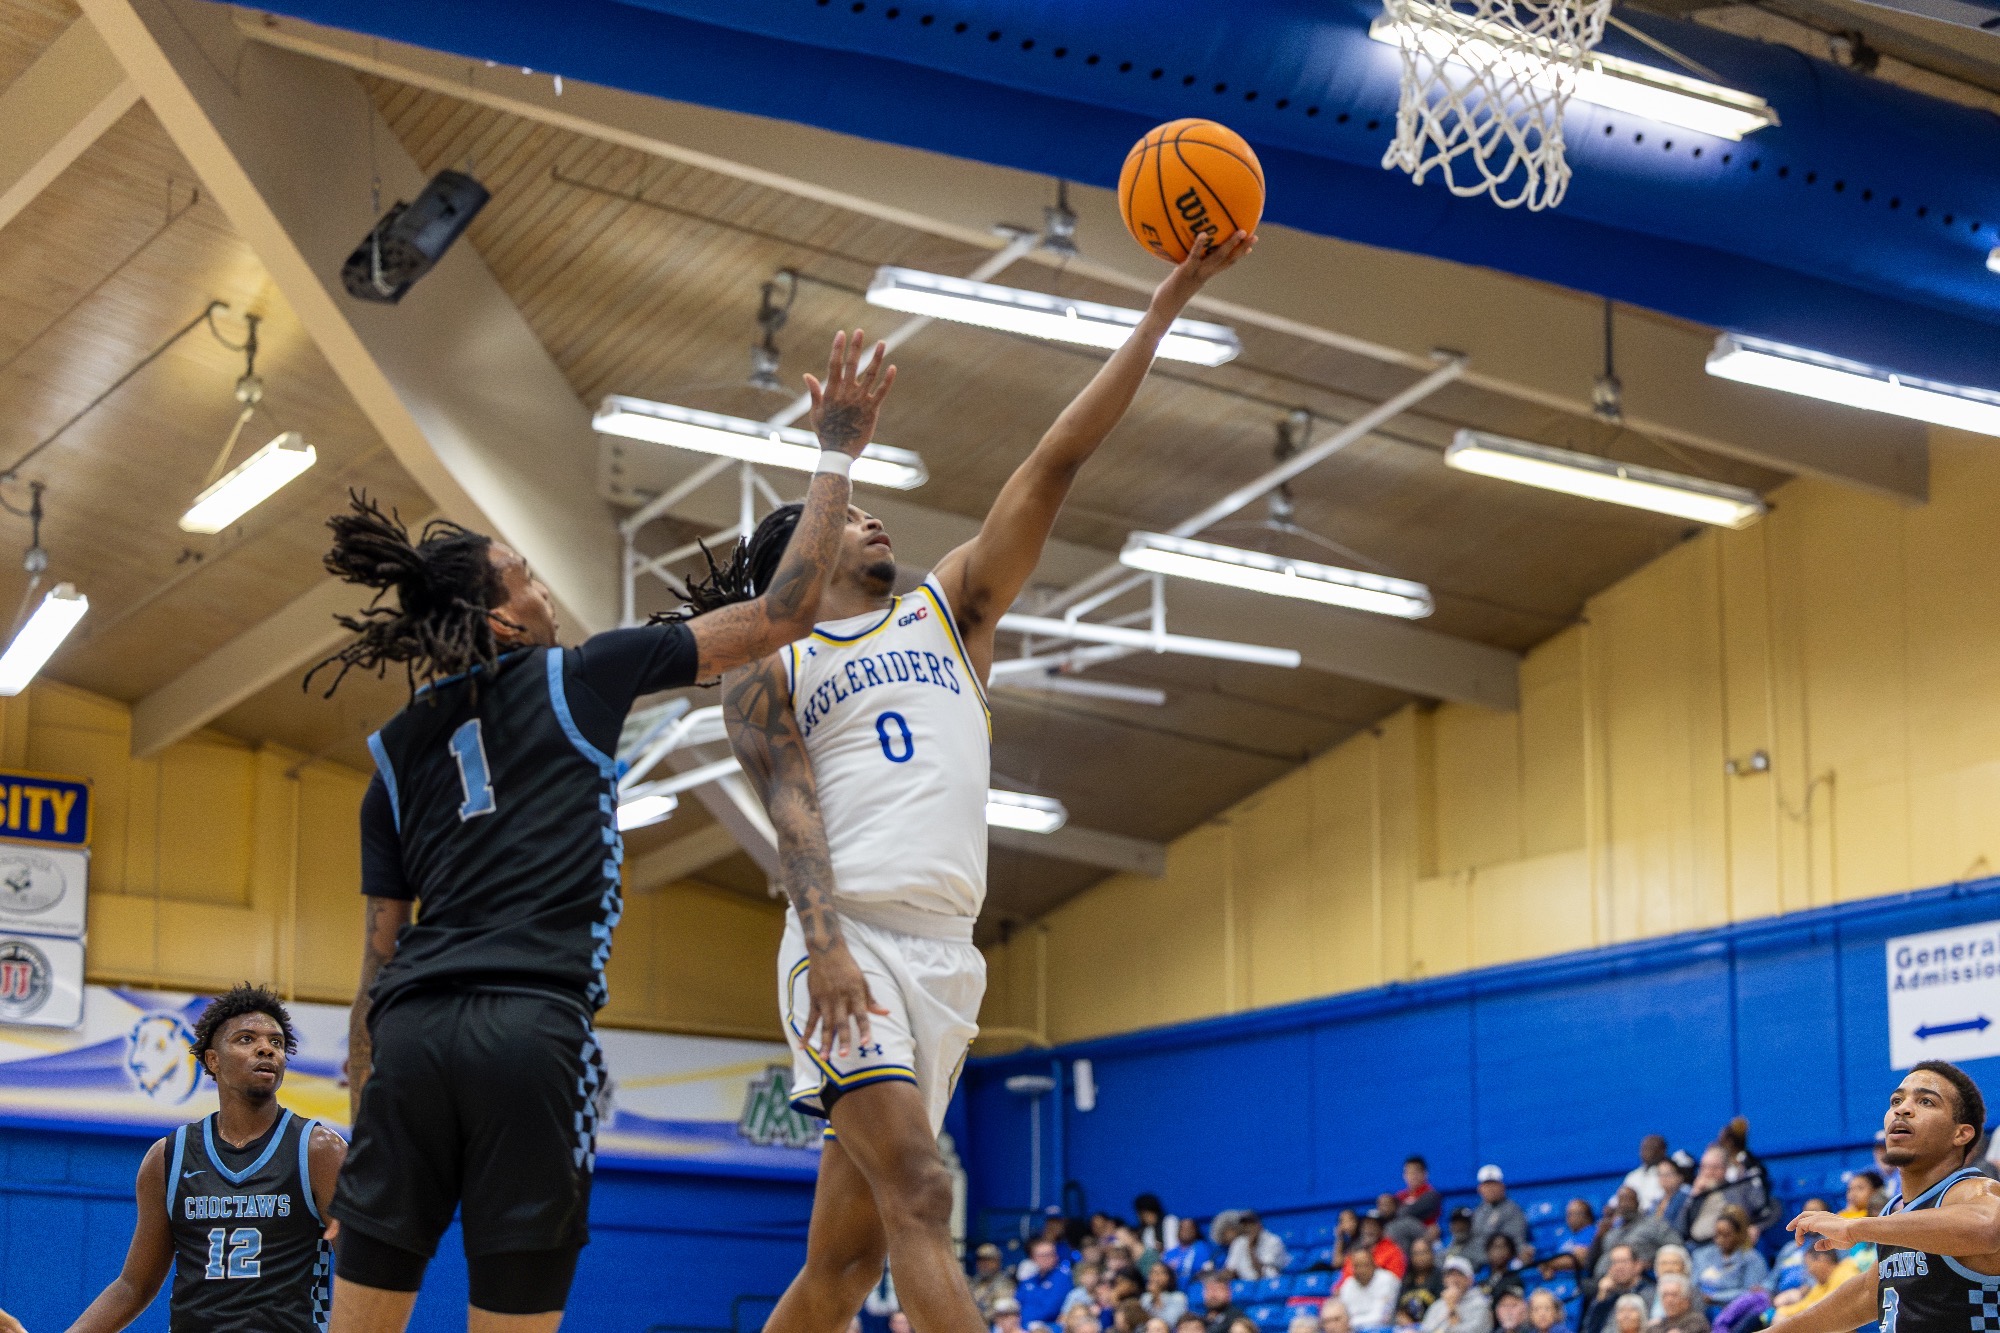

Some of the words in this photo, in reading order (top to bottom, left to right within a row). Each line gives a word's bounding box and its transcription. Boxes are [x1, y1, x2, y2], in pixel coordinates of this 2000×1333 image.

[898, 606, 928, 628] GAC
[875, 710, 914, 763] 0
[448, 717, 496, 823] 1
[0, 781, 78, 835] ITY
[185, 1193, 291, 1220] CHOCTAWS
[204, 1227, 262, 1280] 12
